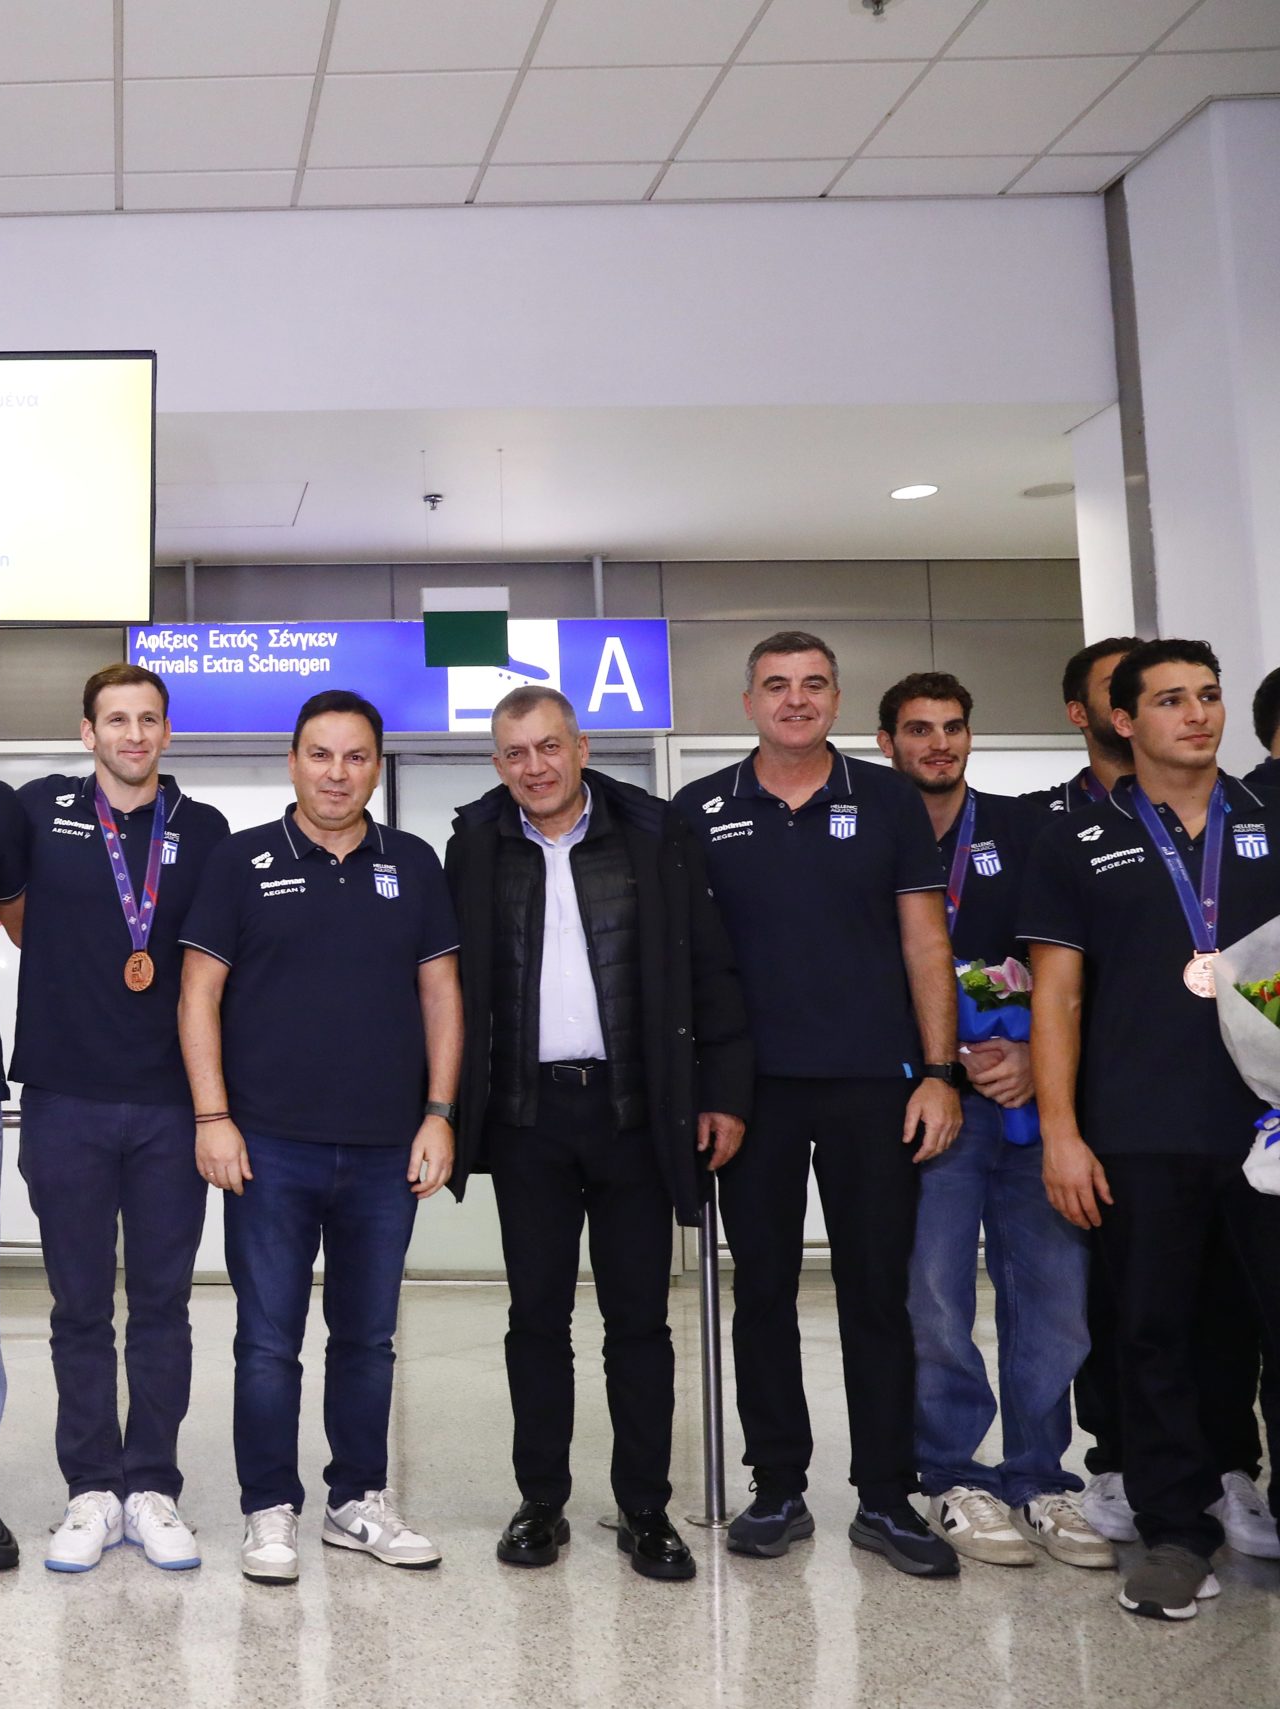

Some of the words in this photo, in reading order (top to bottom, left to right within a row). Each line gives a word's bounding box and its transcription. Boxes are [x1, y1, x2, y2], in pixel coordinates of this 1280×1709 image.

[135, 630, 199, 652] Αφίξεις
[209, 629, 259, 651] Εκτός
[268, 628, 338, 651] Σένγκεν
[136, 655, 199, 674] Arrivals
[203, 655, 244, 673] Extra
[248, 654, 330, 676] Schengen
[586, 636, 645, 712] A
[51, 827, 84, 837] AEGEAN
[711, 830, 746, 843] AEGEAN
[1095, 857, 1136, 875] AEGEAN
[263, 886, 299, 898] AEGEAN
